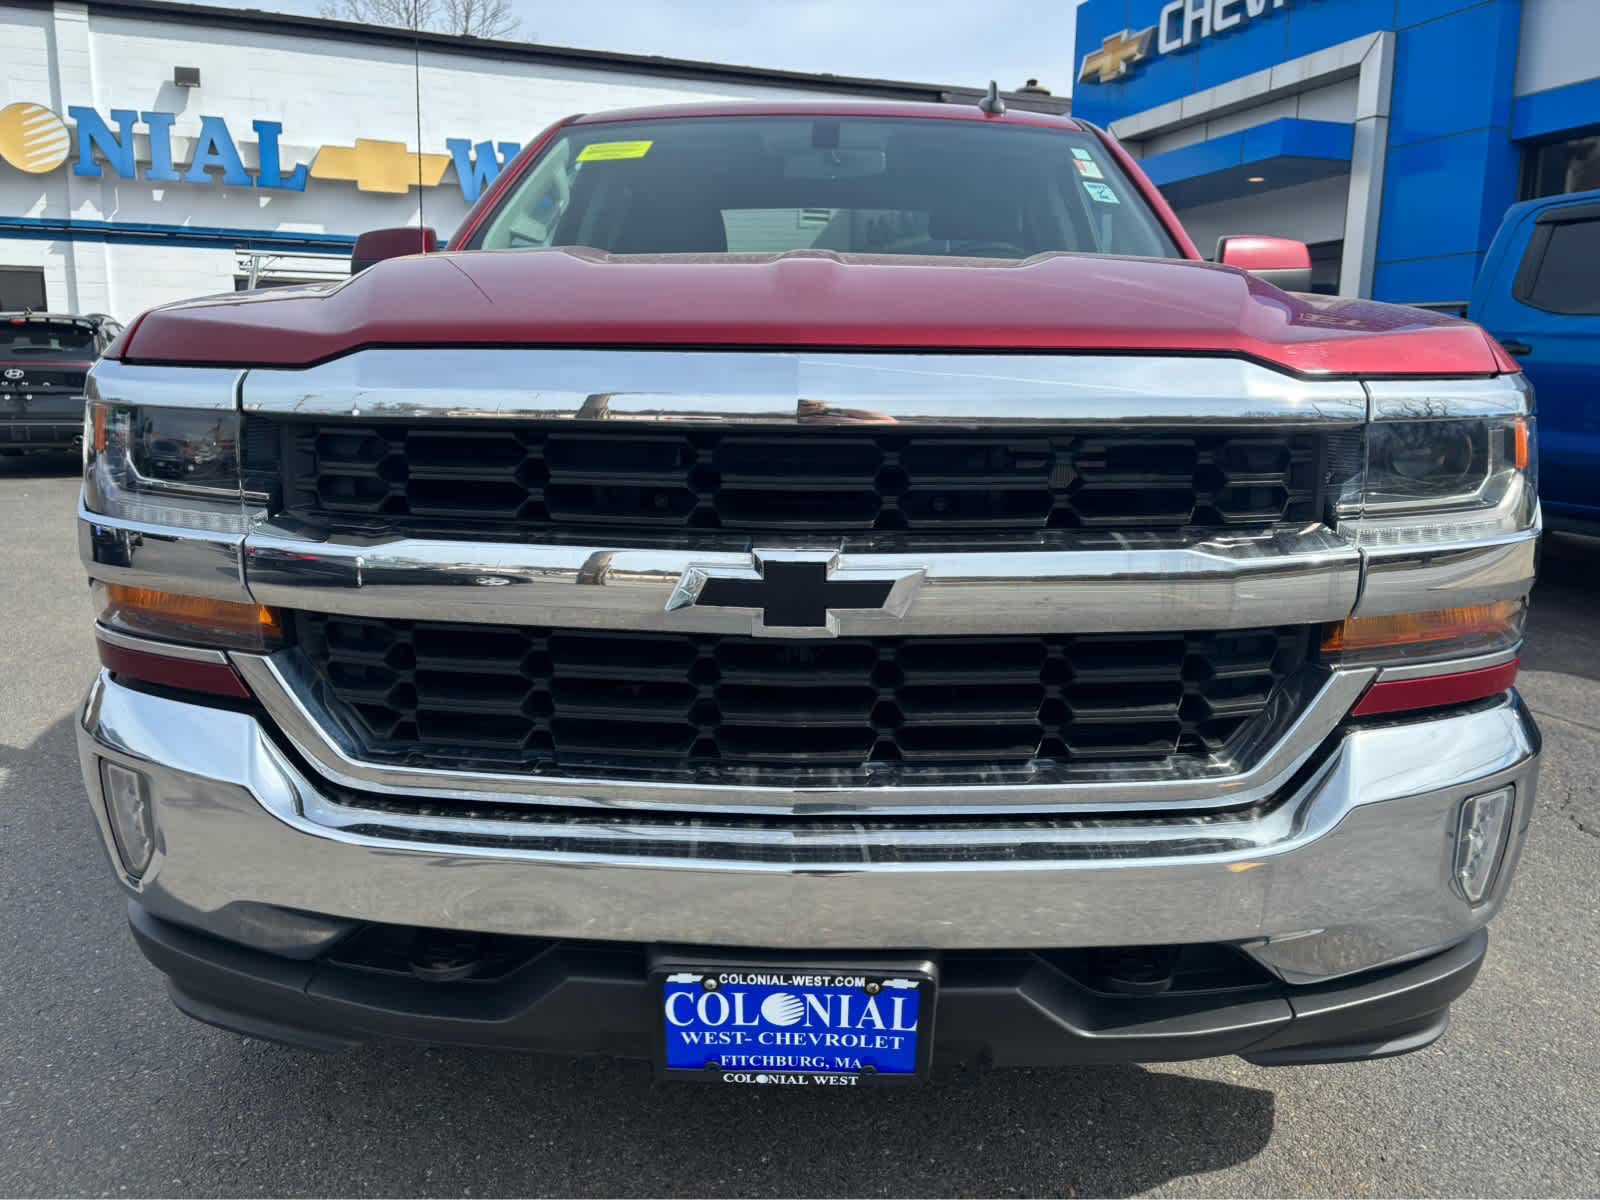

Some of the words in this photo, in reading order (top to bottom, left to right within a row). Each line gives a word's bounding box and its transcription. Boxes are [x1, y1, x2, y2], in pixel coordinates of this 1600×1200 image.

[1158, 0, 1285, 54] CHE
[719, 973, 866, 987] COLONIAL-WEST.COM
[665, 991, 919, 1032] COLONIAL
[758, 1031, 905, 1050] CHEVROLET
[720, 1055, 830, 1069] FITCHBURG,
[834, 1057, 862, 1069] MA
[723, 1073, 809, 1085] COLONIAL
[814, 1075, 859, 1086] WEST
